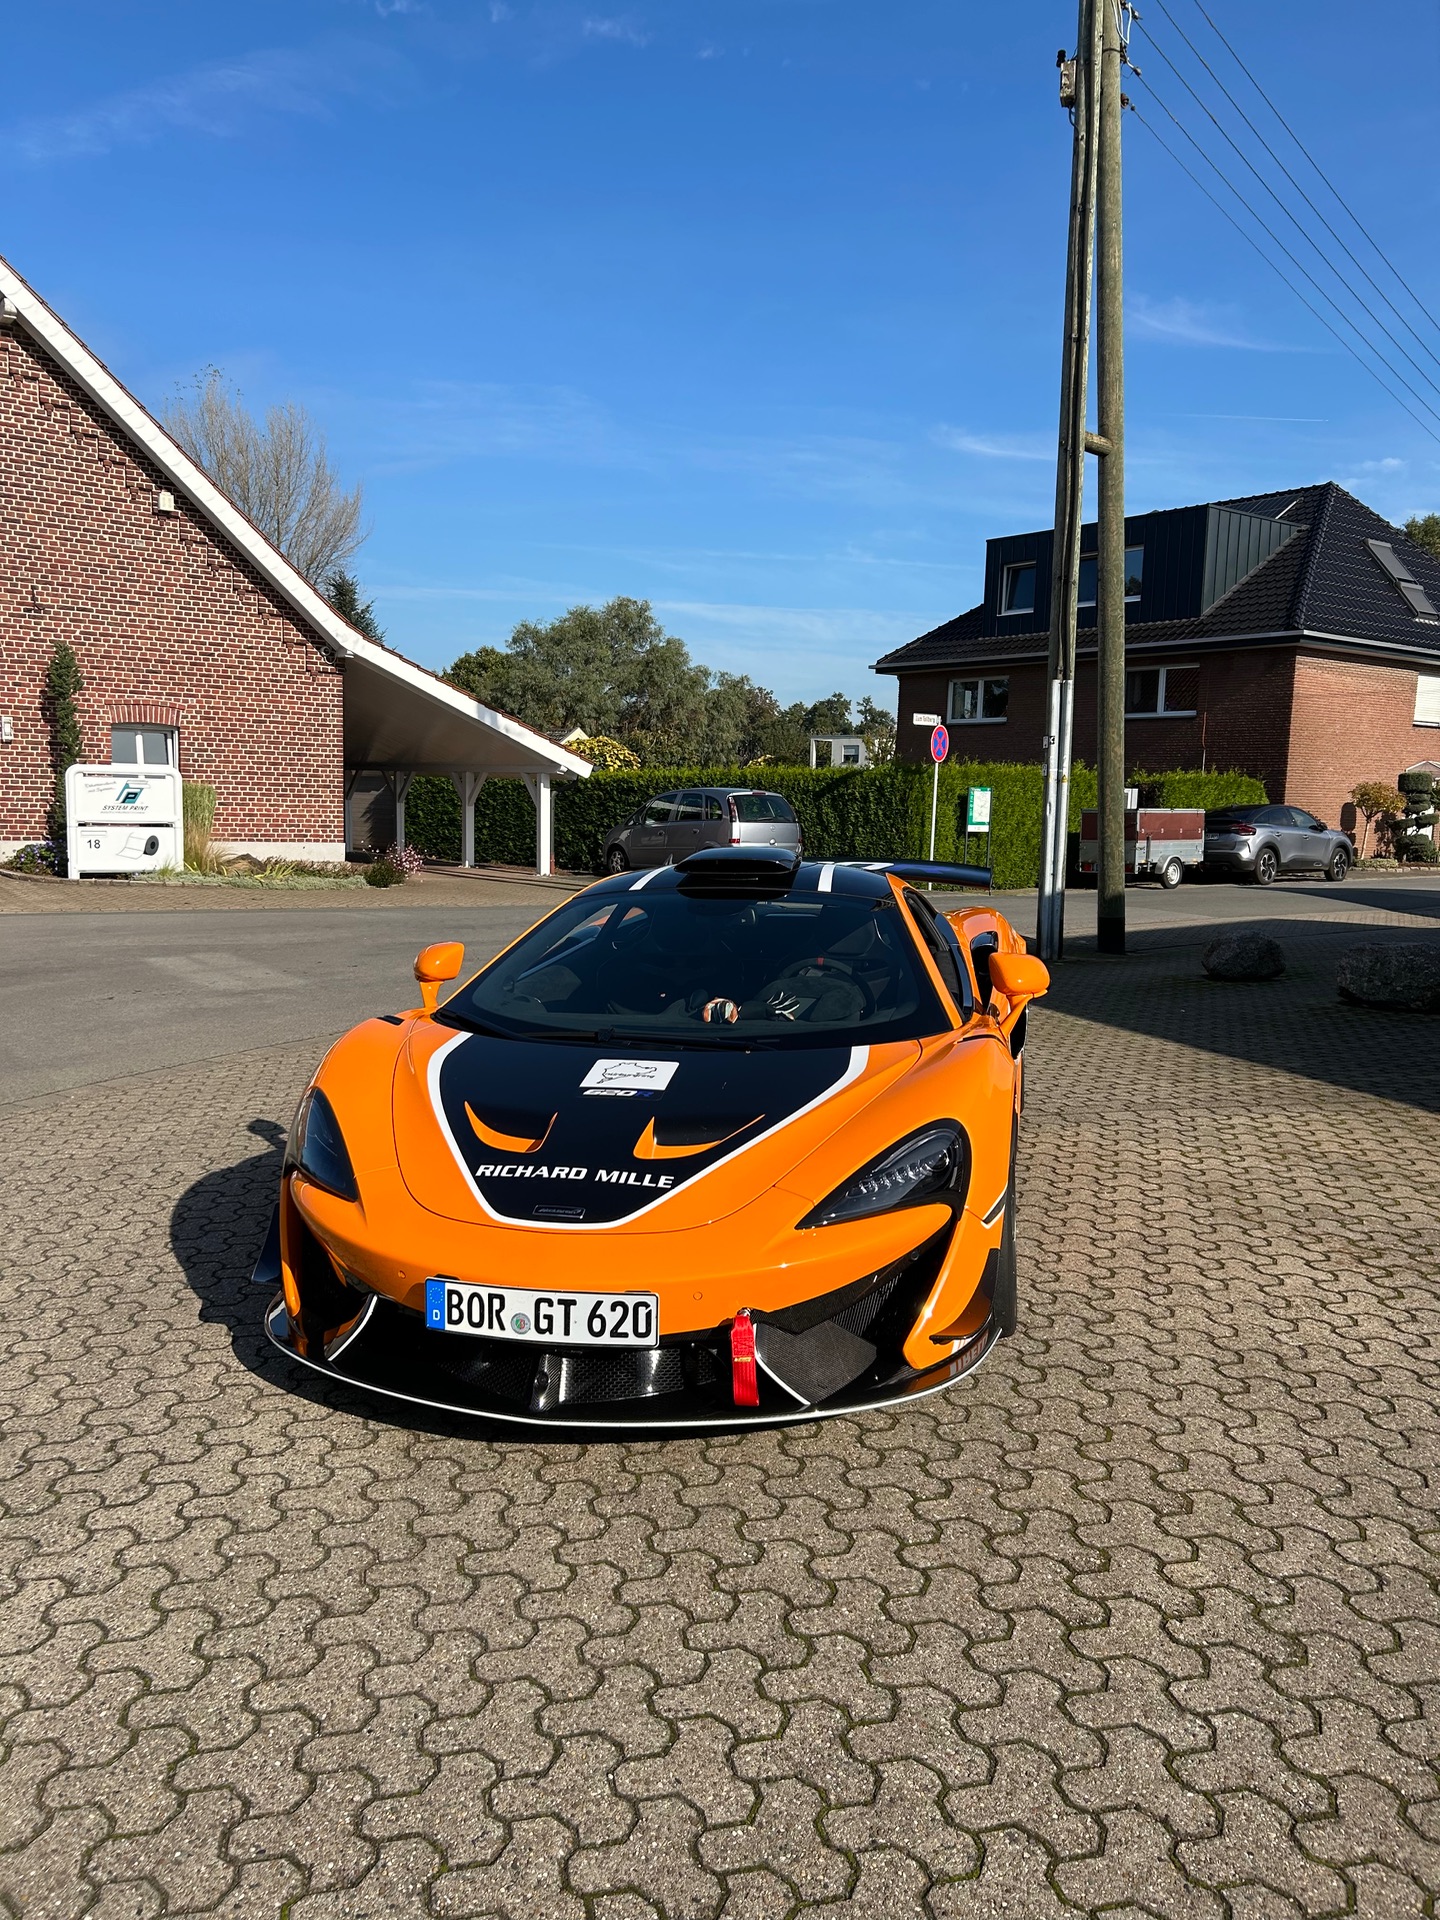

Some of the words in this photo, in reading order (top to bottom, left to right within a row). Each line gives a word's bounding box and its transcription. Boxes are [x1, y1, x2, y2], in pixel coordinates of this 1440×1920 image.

[87, 839, 101, 849] 18
[475, 1164, 588, 1181] RICHARD
[594, 1169, 675, 1189] MILLE
[432, 1309, 441, 1321] D
[446, 1288, 506, 1331] BOR
[534, 1297, 577, 1337] GT
[587, 1300, 652, 1338] 620
